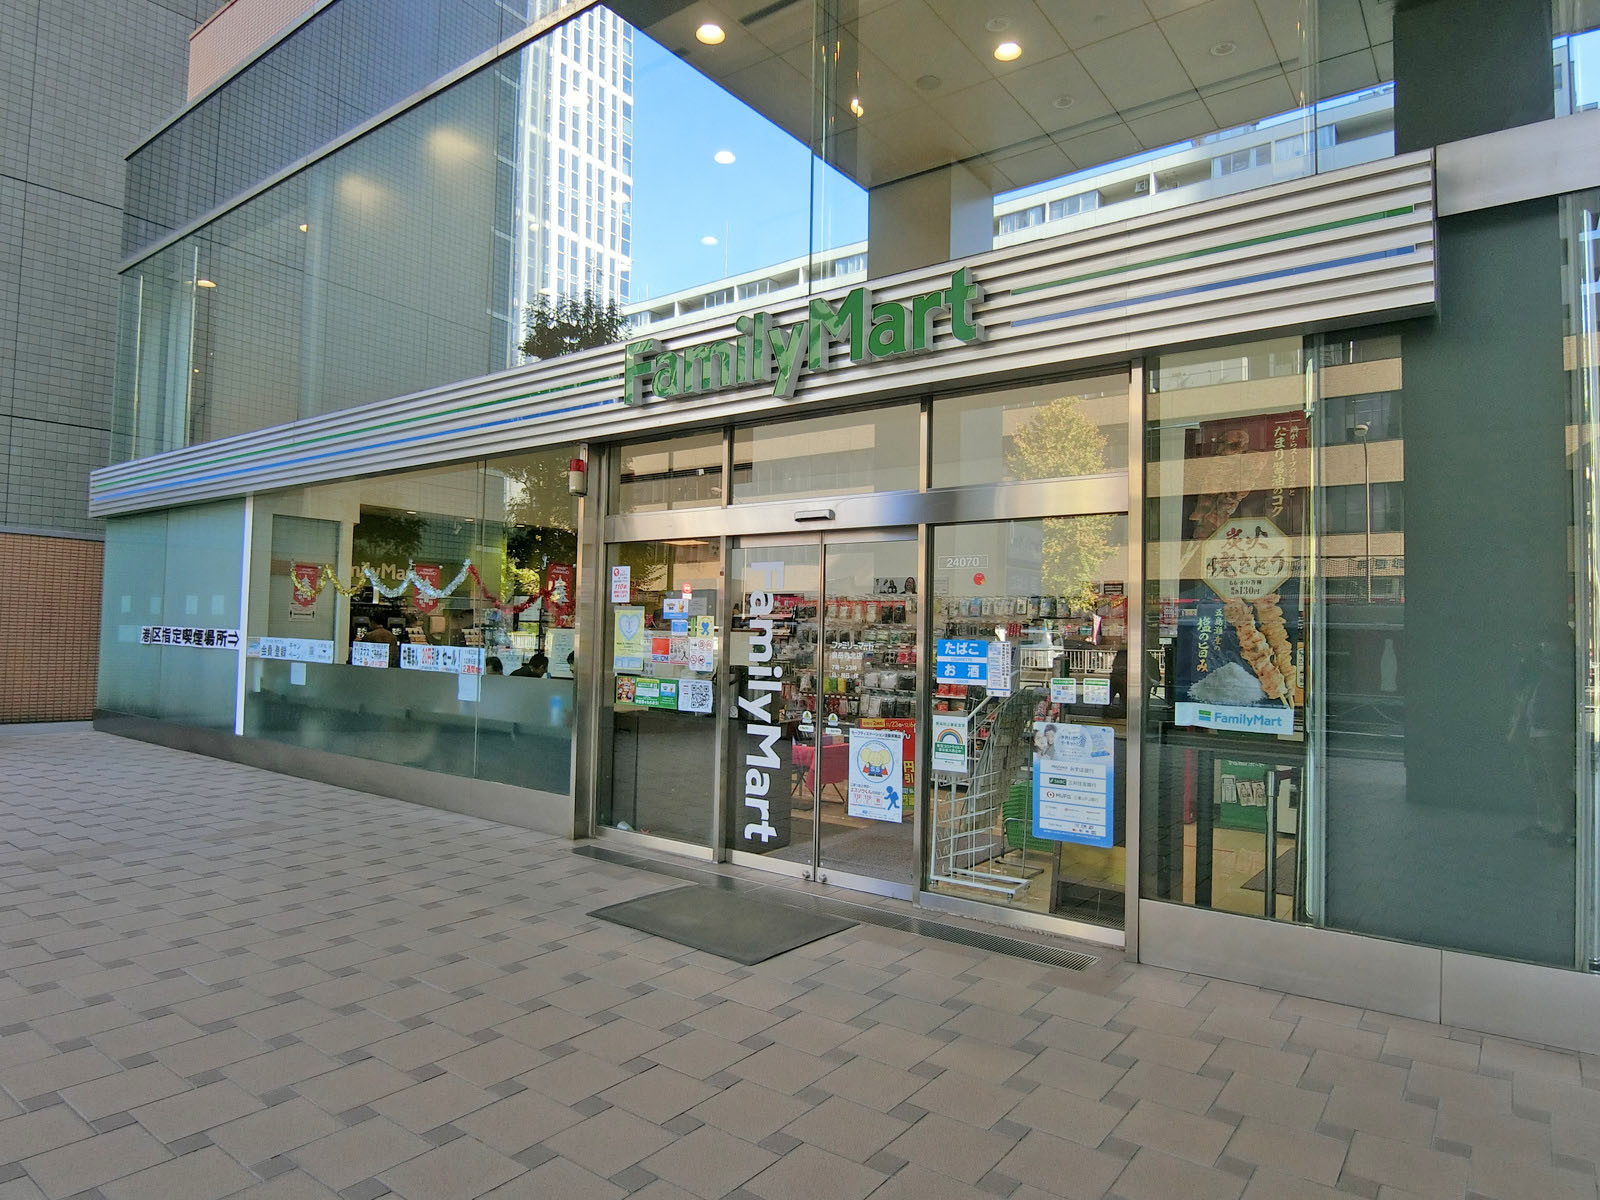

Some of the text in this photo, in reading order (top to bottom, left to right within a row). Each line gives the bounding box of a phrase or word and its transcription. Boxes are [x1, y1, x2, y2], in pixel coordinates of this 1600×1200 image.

[624, 266, 982, 406] FamilyMart
[946, 557, 980, 568] 24070
[142, 626, 228, 647] 港区指定喫煙場所
[1196, 616, 1211, 672] 塩の旨み
[944, 641, 980, 655] たばこ
[739, 561, 785, 843] FamilyMart
[1214, 711, 1283, 727] FamilyMart
